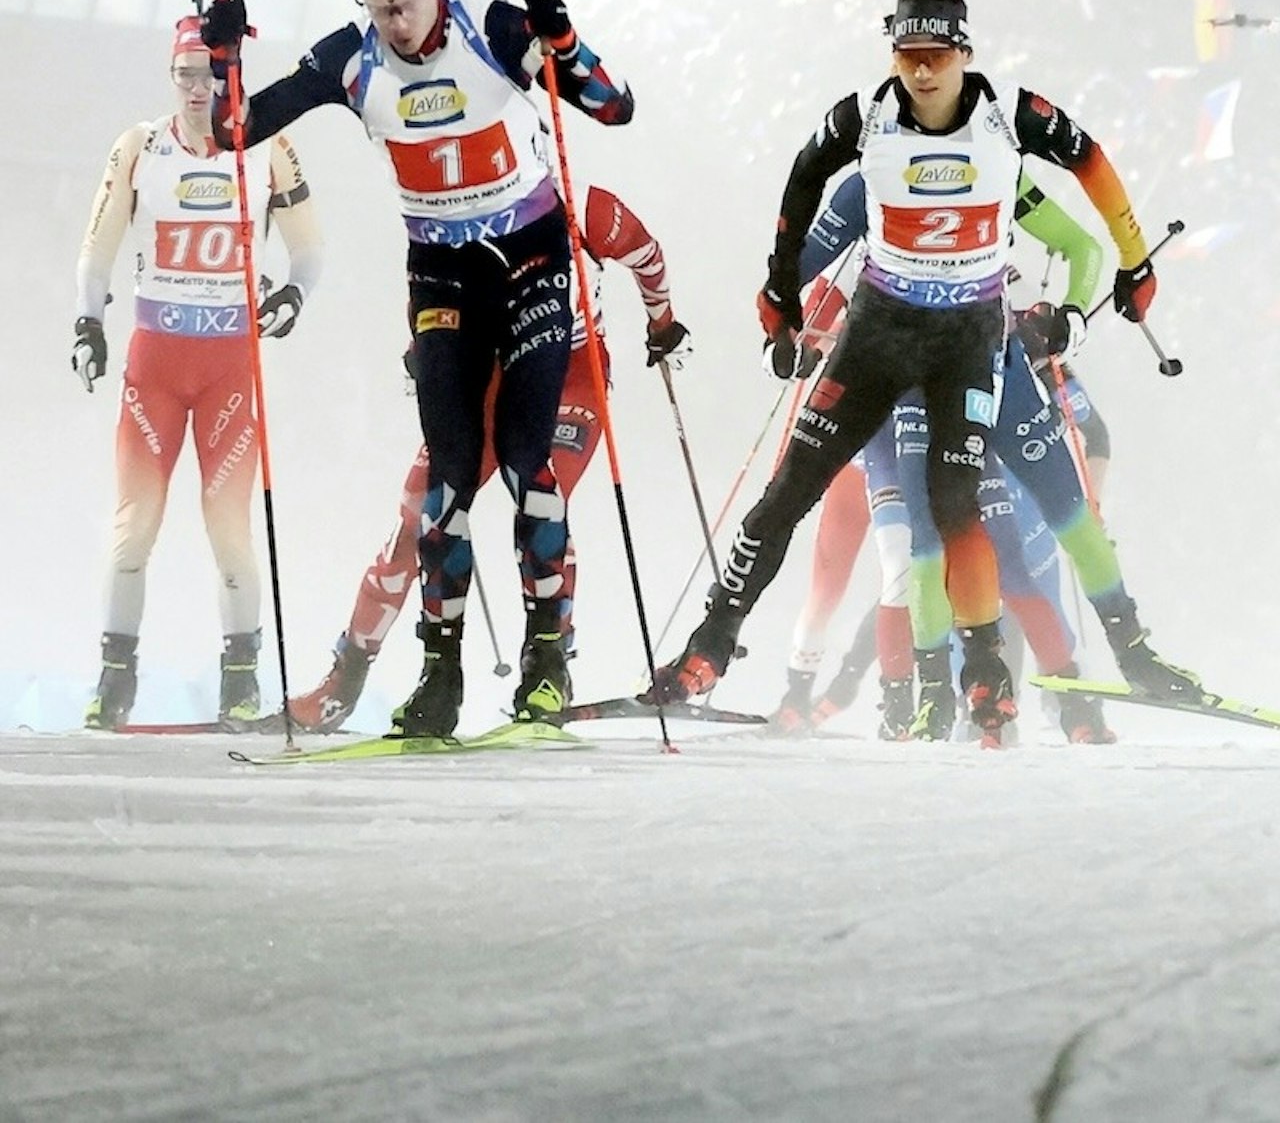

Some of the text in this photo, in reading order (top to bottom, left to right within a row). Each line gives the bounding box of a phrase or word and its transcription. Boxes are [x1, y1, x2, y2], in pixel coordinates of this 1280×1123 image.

[428, 139, 509, 189] 1 1
[169, 224, 234, 268] 10
[914, 209, 992, 248] 2 1
[196, 307, 240, 332] iX2
[130, 402, 162, 455] Sunrise
[208, 392, 243, 448] odlo
